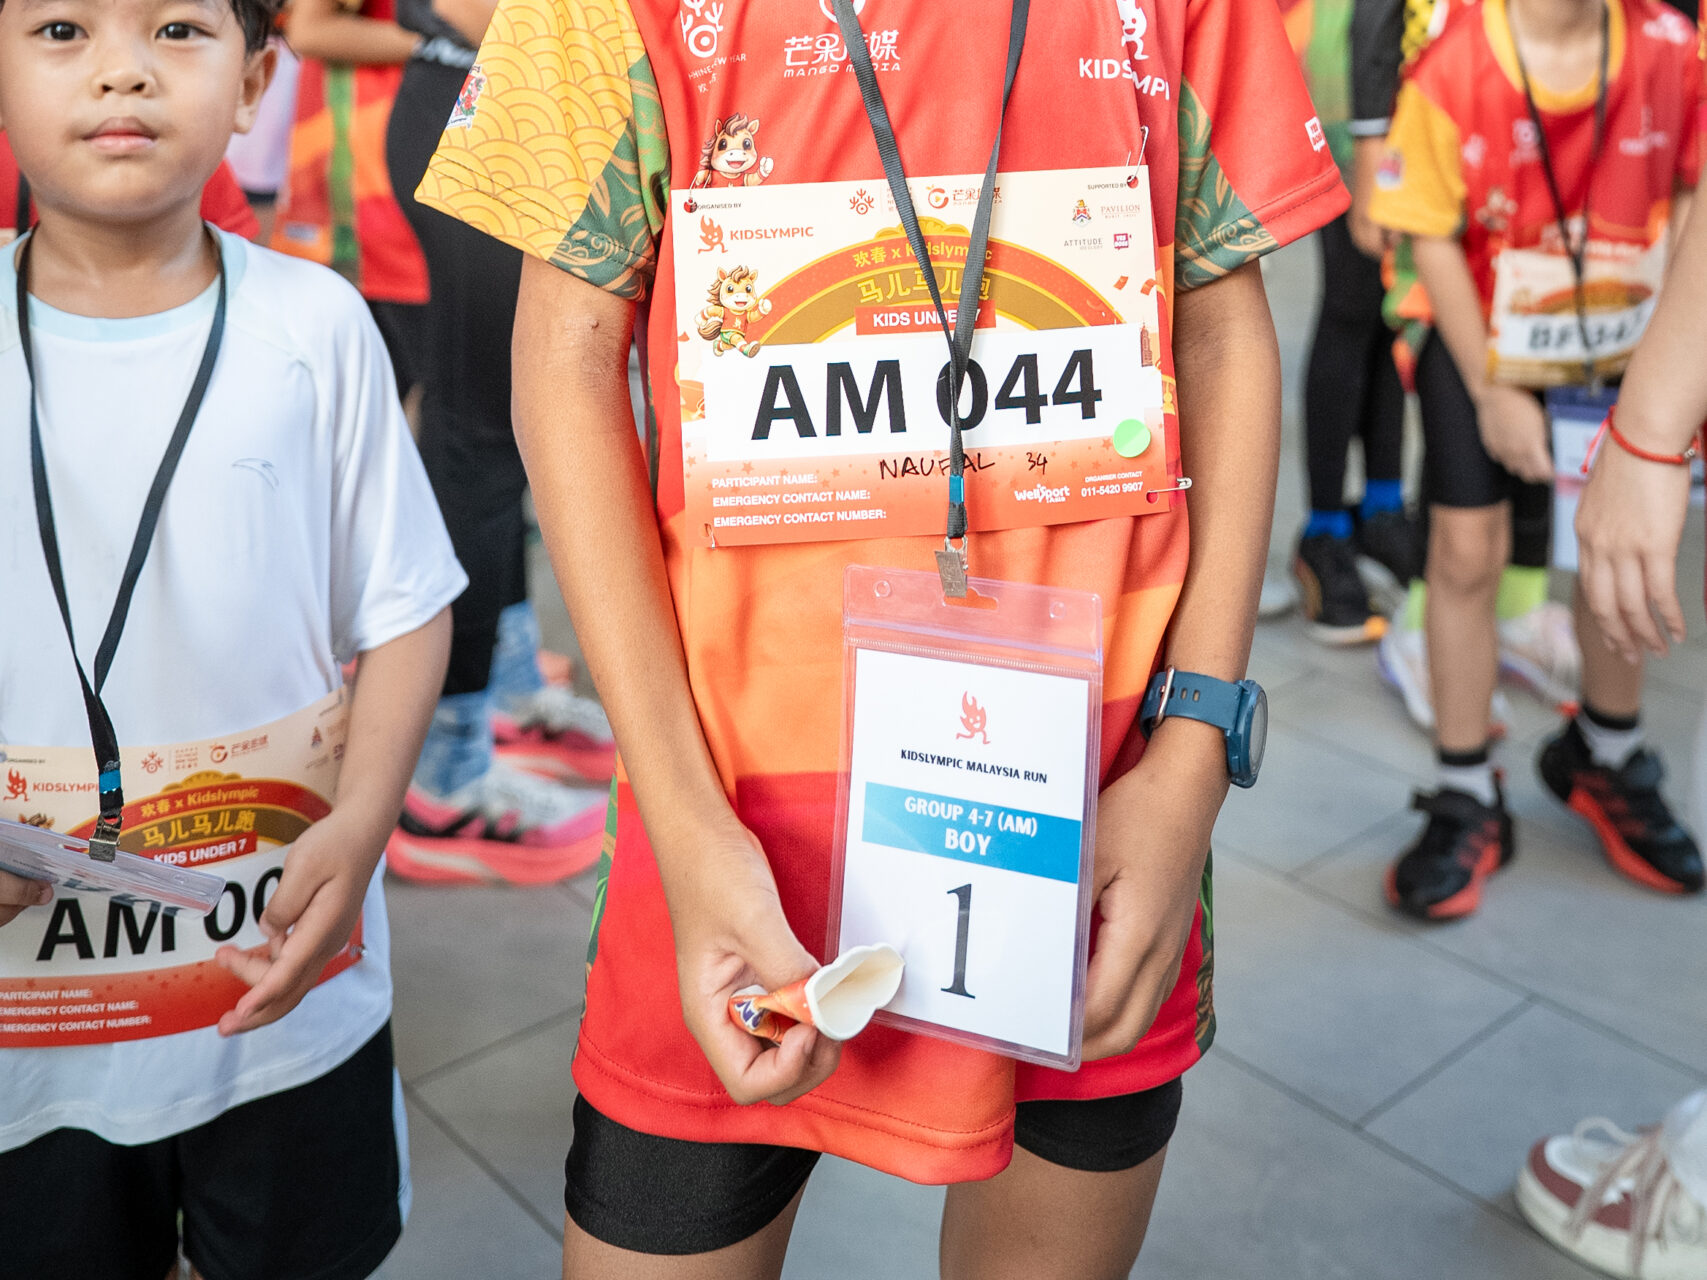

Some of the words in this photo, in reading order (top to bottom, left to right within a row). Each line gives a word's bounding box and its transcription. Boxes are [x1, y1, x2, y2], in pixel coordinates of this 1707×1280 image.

[784, 29, 901, 67] 芒果媒
[784, 64, 839, 78] MANGO
[846, 62, 901, 73] MDIA
[1088, 182, 1119, 190] SUPPORTED
[1100, 204, 1140, 213] PAVILION
[730, 226, 814, 241] KIDSLYMPIC
[1064, 238, 1103, 247] ATTITUDE
[853, 246, 887, 268] 欢春
[873, 312, 911, 327] KIDS
[914, 309, 958, 325] UNDE
[751, 359, 907, 440] AM
[936, 349, 1102, 432] 044
[1026, 452, 1048, 475] 34
[712, 475, 781, 488] PARTICIPANT
[783, 474, 818, 485] NAME:
[1117, 471, 1143, 480] CONTACT
[713, 494, 781, 507] EMERGENCY
[783, 491, 833, 504] CONTACT
[835, 489, 871, 501] NAME:
[1081, 483, 1120, 497] 011-5420
[1122, 481, 1143, 493] 9907
[714, 514, 782, 527] EMERGENCY
[783, 511, 834, 524] CONTACT
[836, 508, 887, 521] NUMBER:
[900, 749, 963, 769] KIDSLYMPIC
[966, 761, 1020, 779] MALAYSIA
[1023, 770, 1048, 784] RUN
[32, 782, 99, 793] KIDSLYMPI
[187, 786, 259, 806] Kidslympic
[904, 796, 964, 821] GROUP
[968, 807, 994, 828] 4-7
[997, 811, 1038, 838] (AM)
[944, 827, 992, 856] BOY
[154, 850, 187, 865] KIDS
[190, 841, 237, 861] UNDER
[239, 838, 248, 851] 7
[36, 894, 176, 962] AM
[940, 882, 977, 999] 1
[61, 989, 92, 999] NAME:
[59, 1003, 105, 1015] CONTACT
[107, 1000, 139, 1012] NAME:
[58, 1020, 105, 1032] CONTACT
[106, 1015, 152, 1028] NUMBER:
